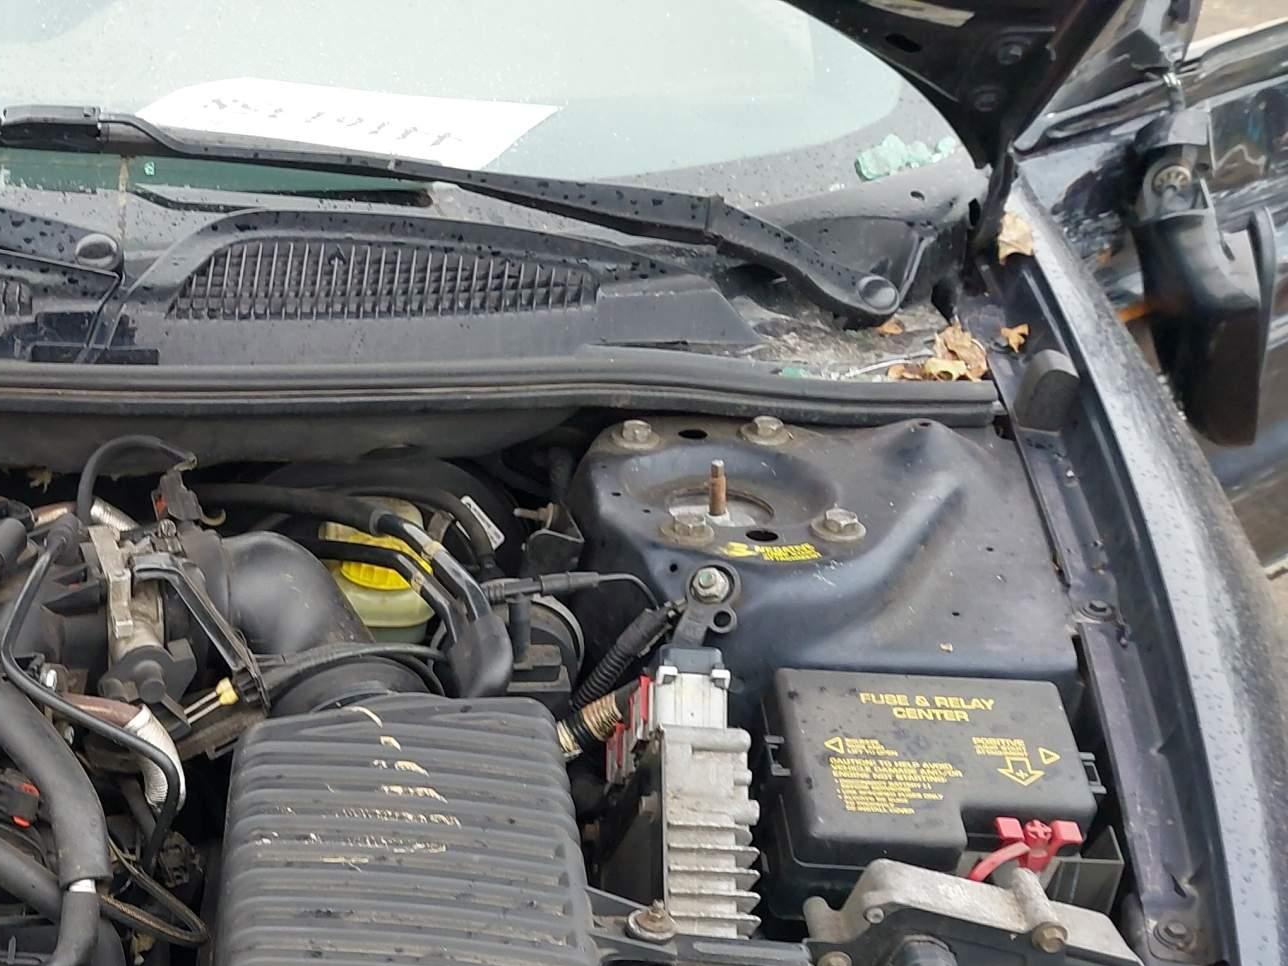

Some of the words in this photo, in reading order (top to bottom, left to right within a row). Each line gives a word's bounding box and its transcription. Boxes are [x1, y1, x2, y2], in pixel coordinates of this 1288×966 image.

[860, 692, 909, 705] FUSE
[915, 695, 930, 707] &
[935, 695, 994, 711] RELAY
[892, 707, 970, 722] CENTER
